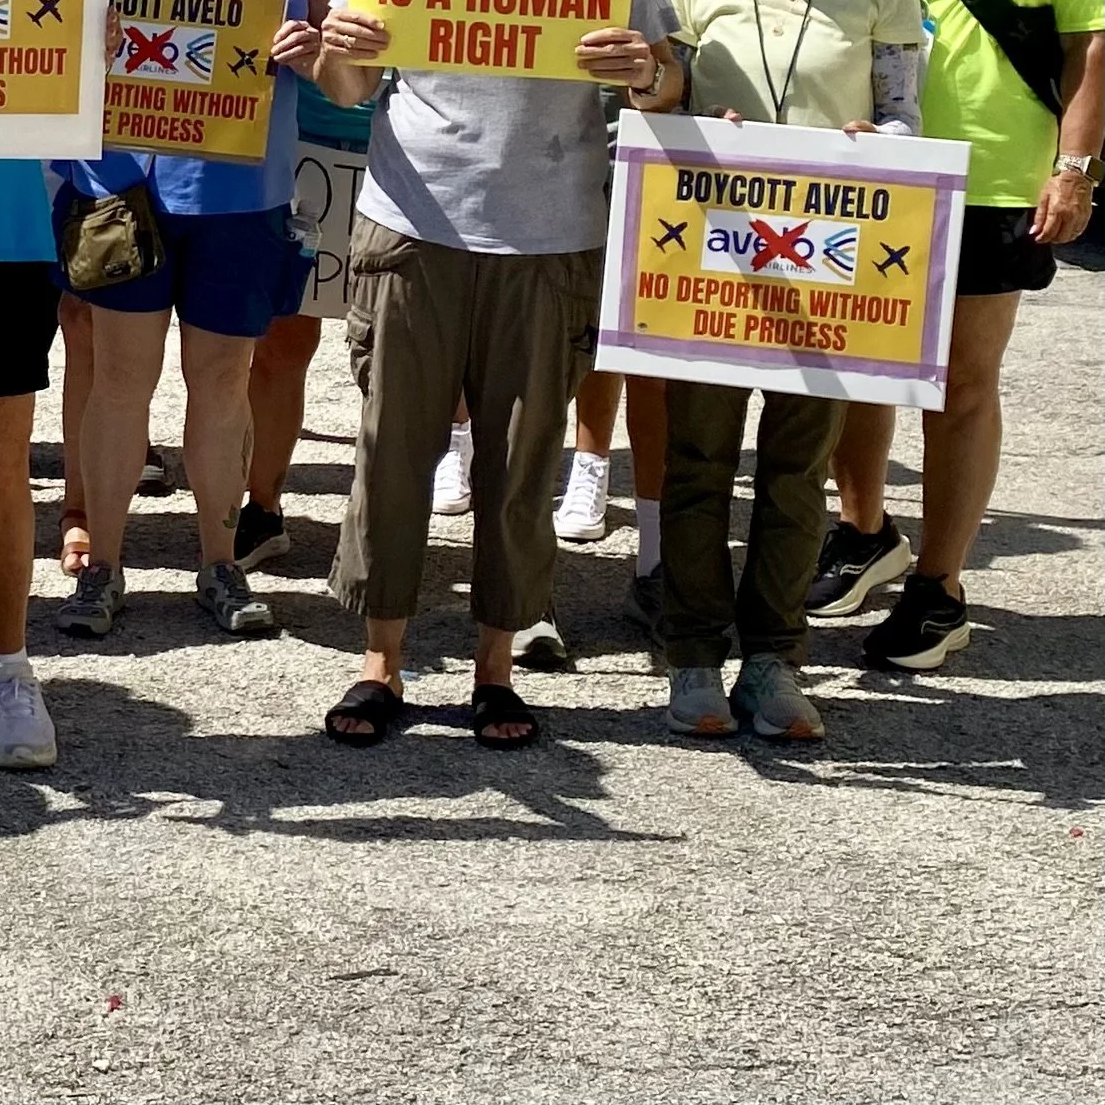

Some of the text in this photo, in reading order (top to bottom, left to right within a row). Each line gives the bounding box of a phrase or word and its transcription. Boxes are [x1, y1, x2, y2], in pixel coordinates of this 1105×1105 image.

[428, 19, 543, 69] RIGHT
[105, 81, 259, 121] RTING WITHOUT
[117, 111, 205, 144] PROCESS
[676, 169, 890, 221] BOYCOTT AVELO
[638, 272, 912, 327] NO DEPORTING WITHOUT
[693, 309, 848, 352] DUE PROCESS
